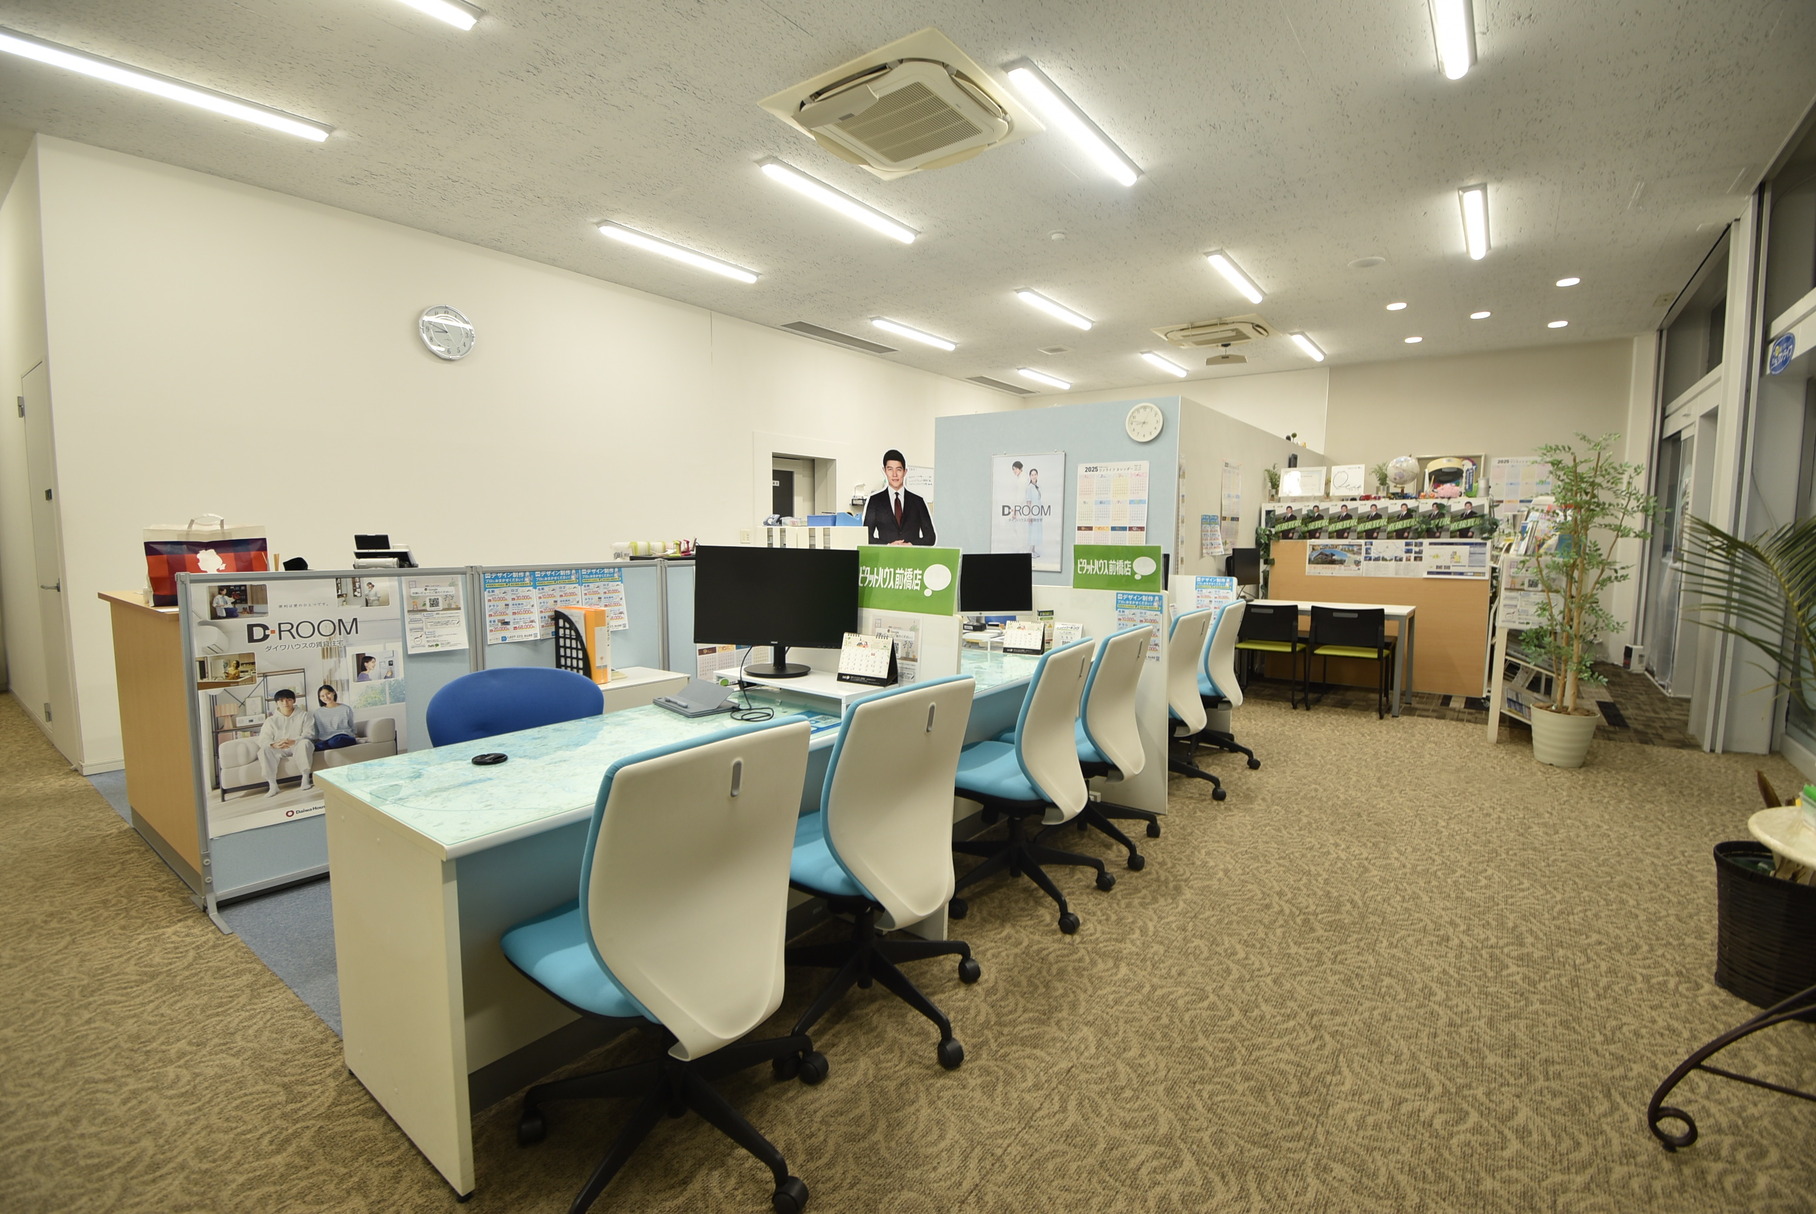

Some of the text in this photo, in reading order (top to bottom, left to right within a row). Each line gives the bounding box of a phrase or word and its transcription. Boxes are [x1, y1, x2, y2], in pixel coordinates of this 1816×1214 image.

[1084, 465, 1098, 473] 2025
[1077, 558, 1132, 576] ピタットハウス前橋店
[858, 565, 922, 591] ピタットハウス前橋店
[265, 639, 344, 652] ダイワハウスの賃貸住宅
